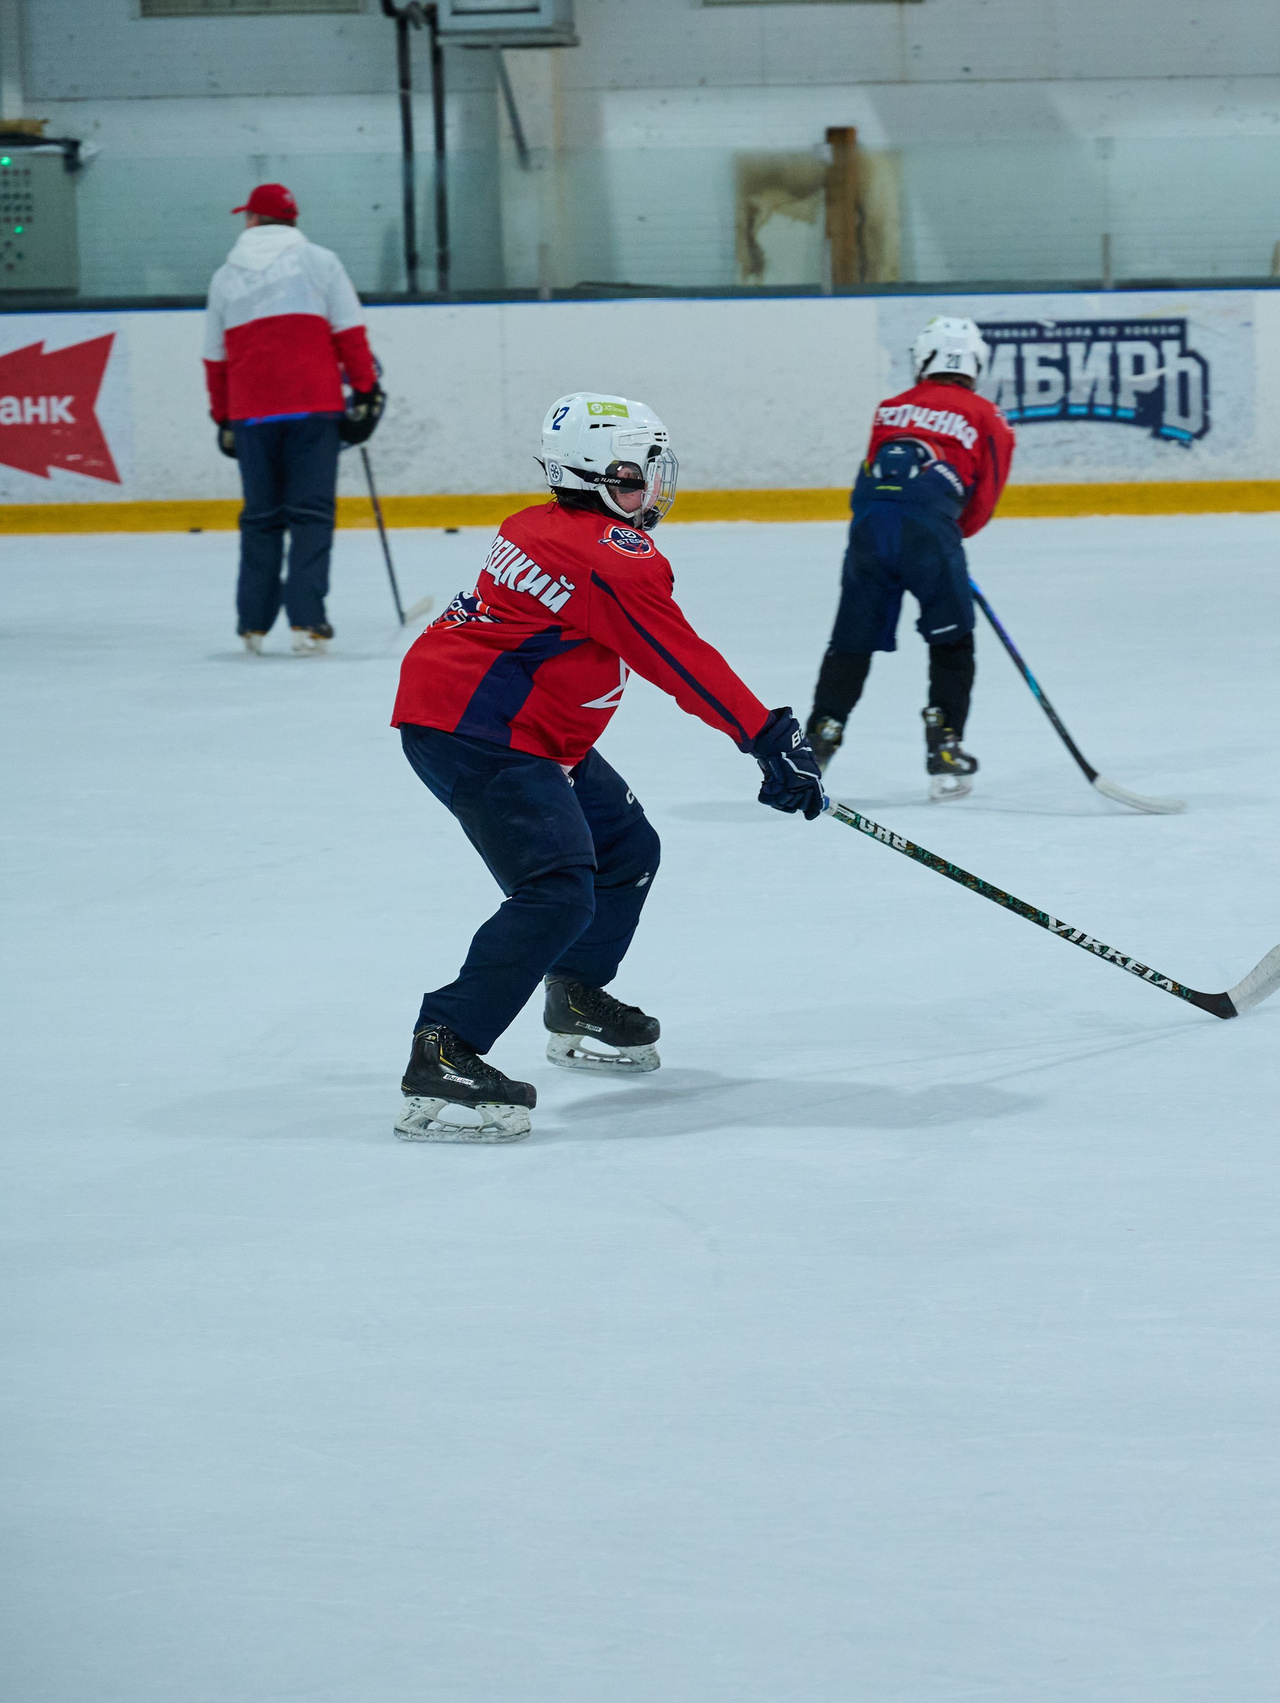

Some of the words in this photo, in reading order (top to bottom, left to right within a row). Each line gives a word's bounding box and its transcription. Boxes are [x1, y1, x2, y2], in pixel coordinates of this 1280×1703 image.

[0, 394, 76, 425] анк
[980, 339, 1204, 437] ИБИРЬ
[1047, 914, 1174, 992] VIKKELA
